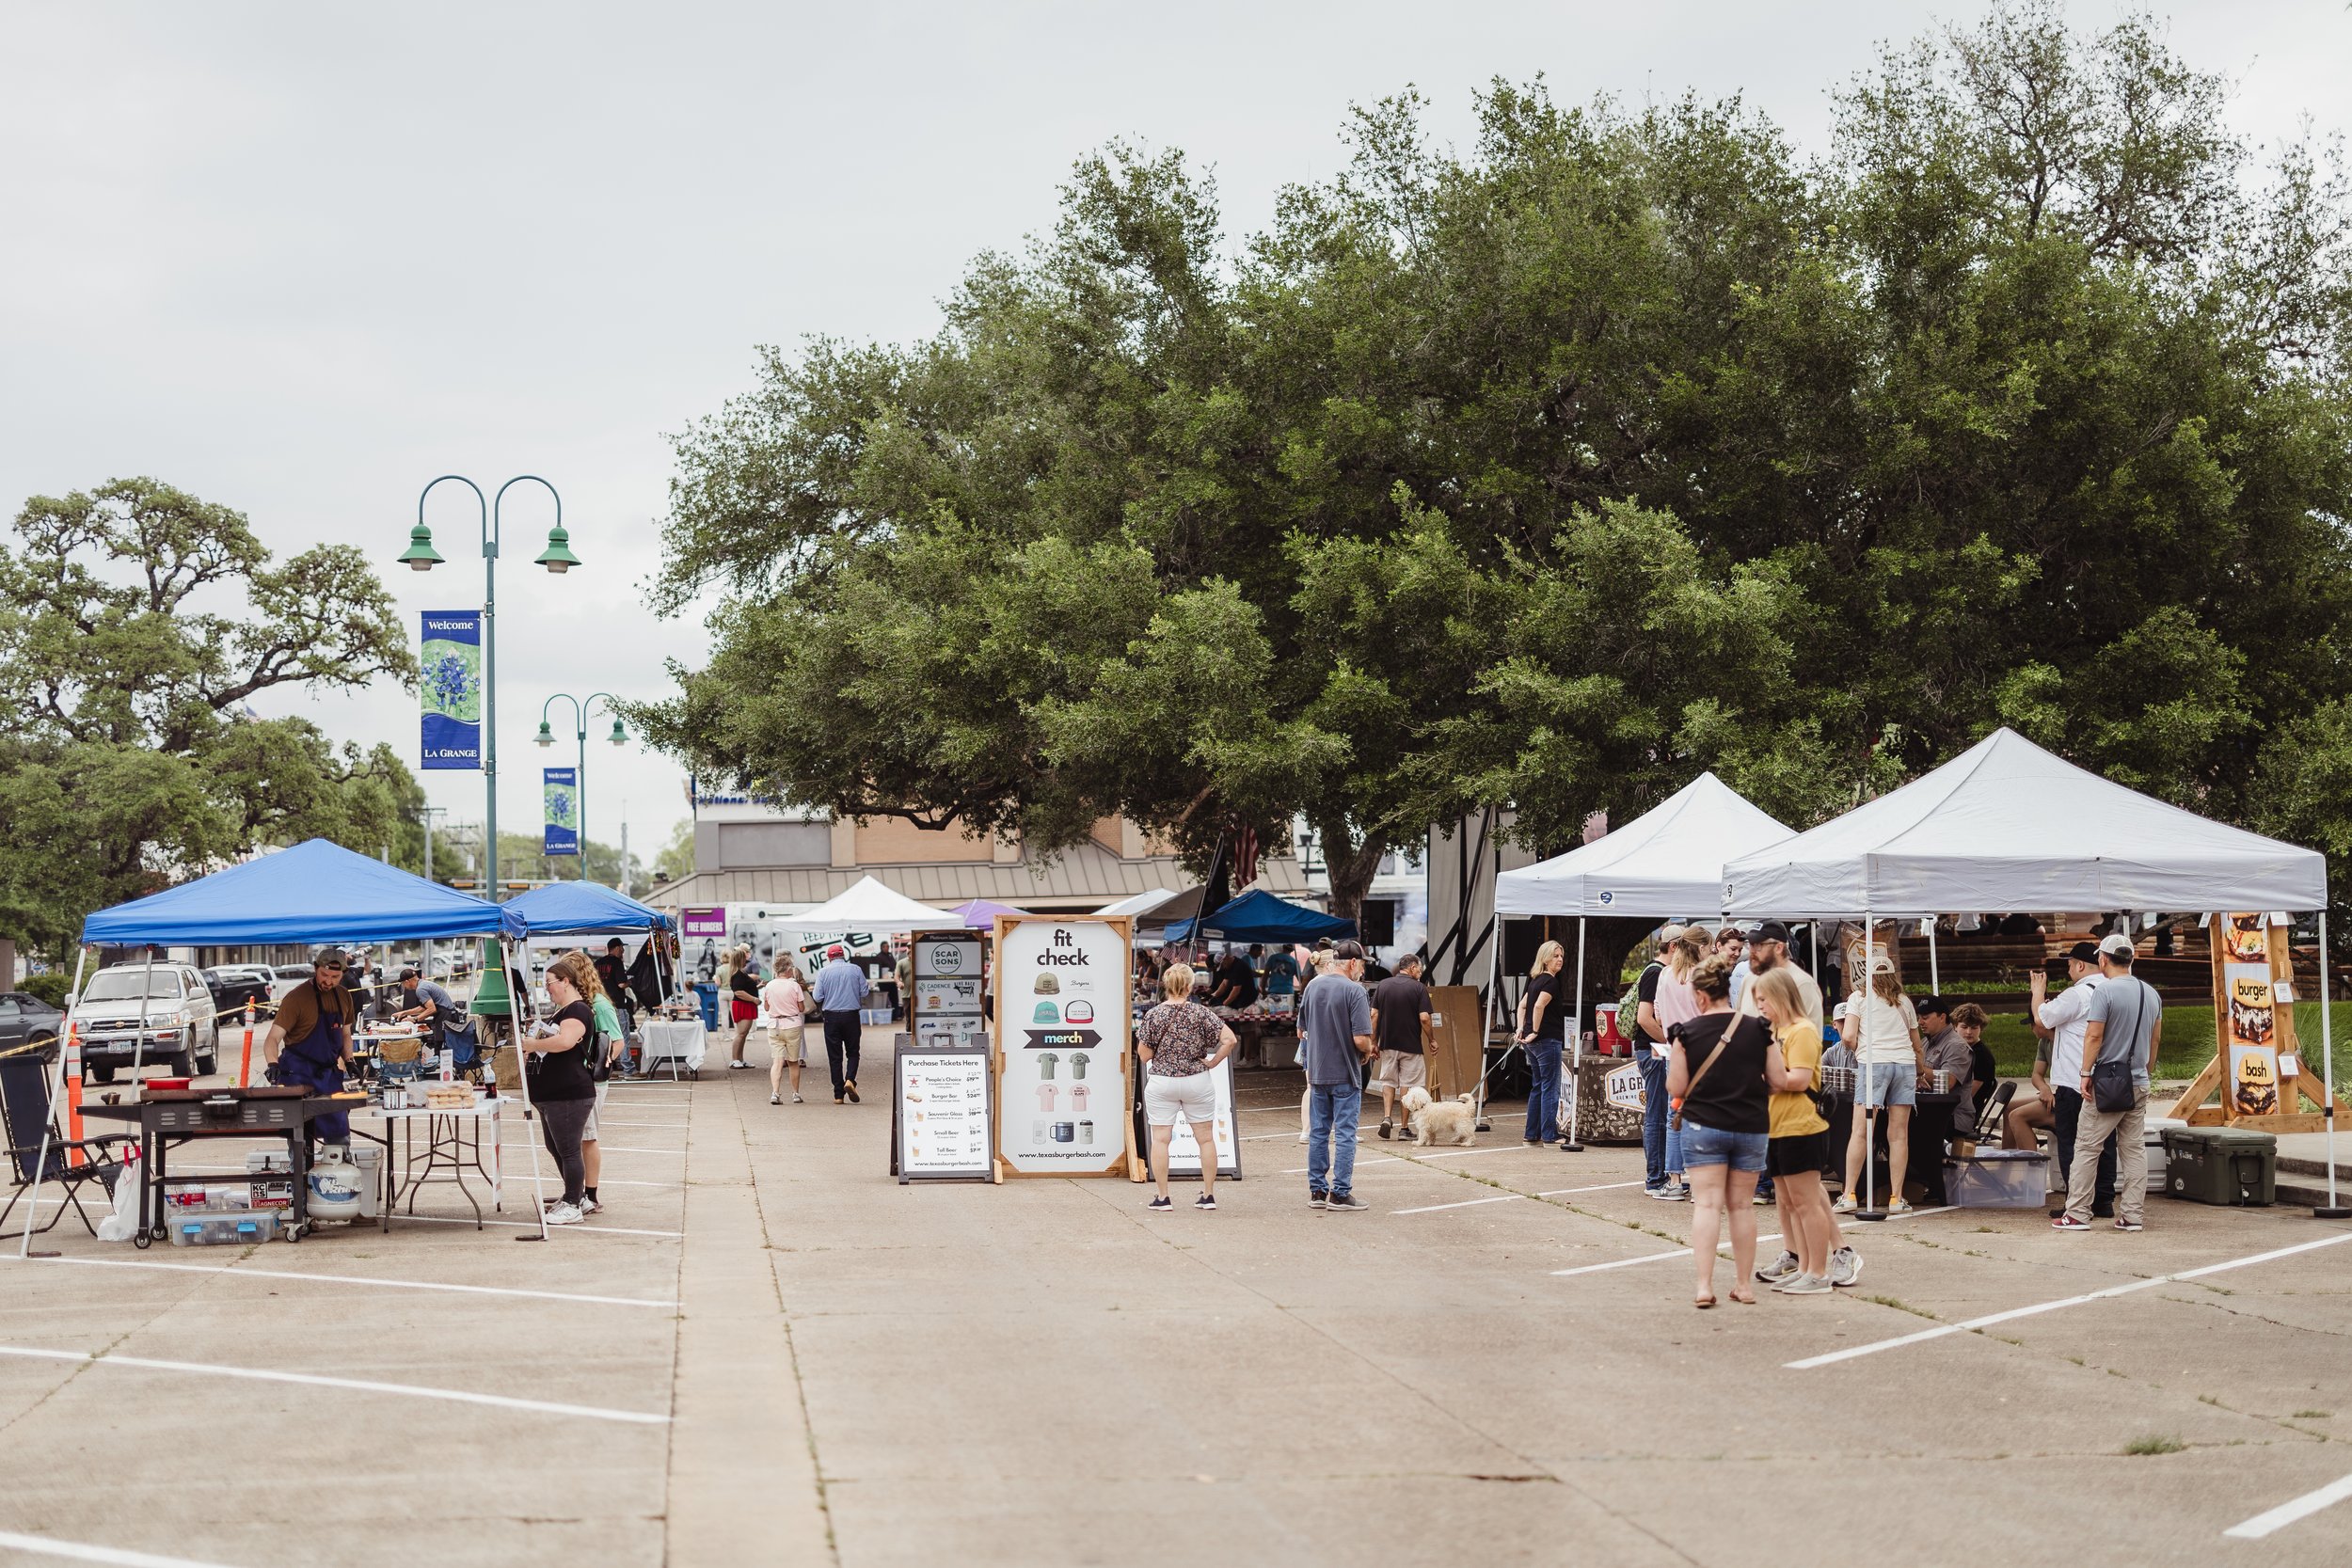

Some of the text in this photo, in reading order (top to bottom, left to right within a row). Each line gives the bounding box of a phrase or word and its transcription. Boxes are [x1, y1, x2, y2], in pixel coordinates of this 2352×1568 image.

[428, 621, 474, 630] Welcome
[424, 749, 478, 758] LA GRANGE
[687, 921, 723, 932] FREE BURGERS
[1053, 928, 1073, 947] fit
[1036, 947, 1089, 966] check
[2237, 979, 2268, 1002] burger
[1044, 1031, 1083, 1043] merch
[2245, 1059, 2267, 1078] bash
[1612, 1078, 1627, 1095] LA
[1018, 1150, 1106, 1159] www.texasburgerbash.com
